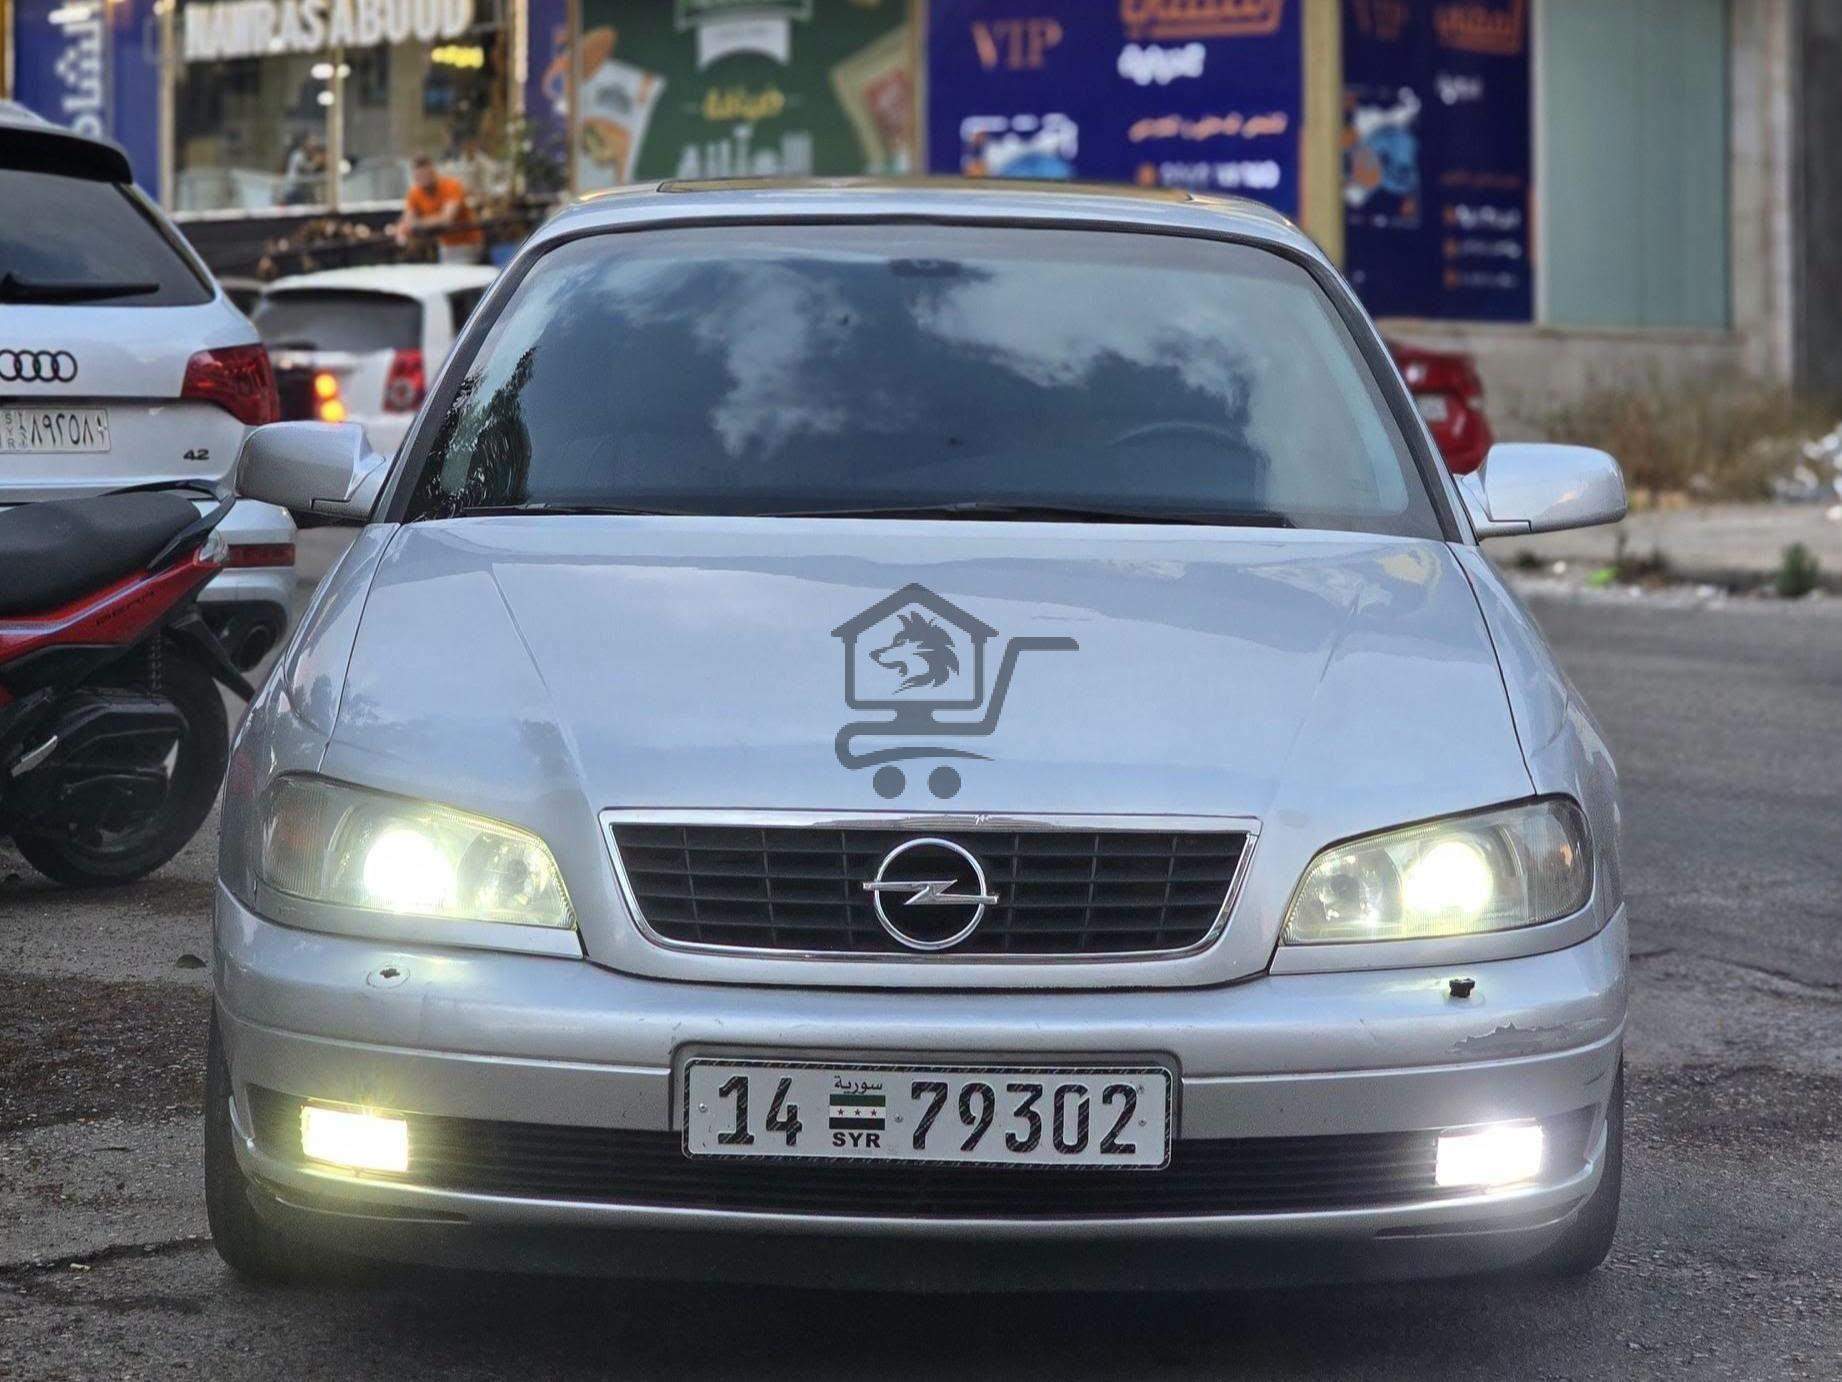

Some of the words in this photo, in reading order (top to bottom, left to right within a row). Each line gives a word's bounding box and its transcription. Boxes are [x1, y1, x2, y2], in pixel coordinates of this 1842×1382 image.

[971, 18, 1064, 69] VIP
[833, 1074, 883, 1095] سورية
[717, 1075, 803, 1147] 14
[911, 1081, 1138, 1155] 79302
[832, 1131, 881, 1149] SYR
